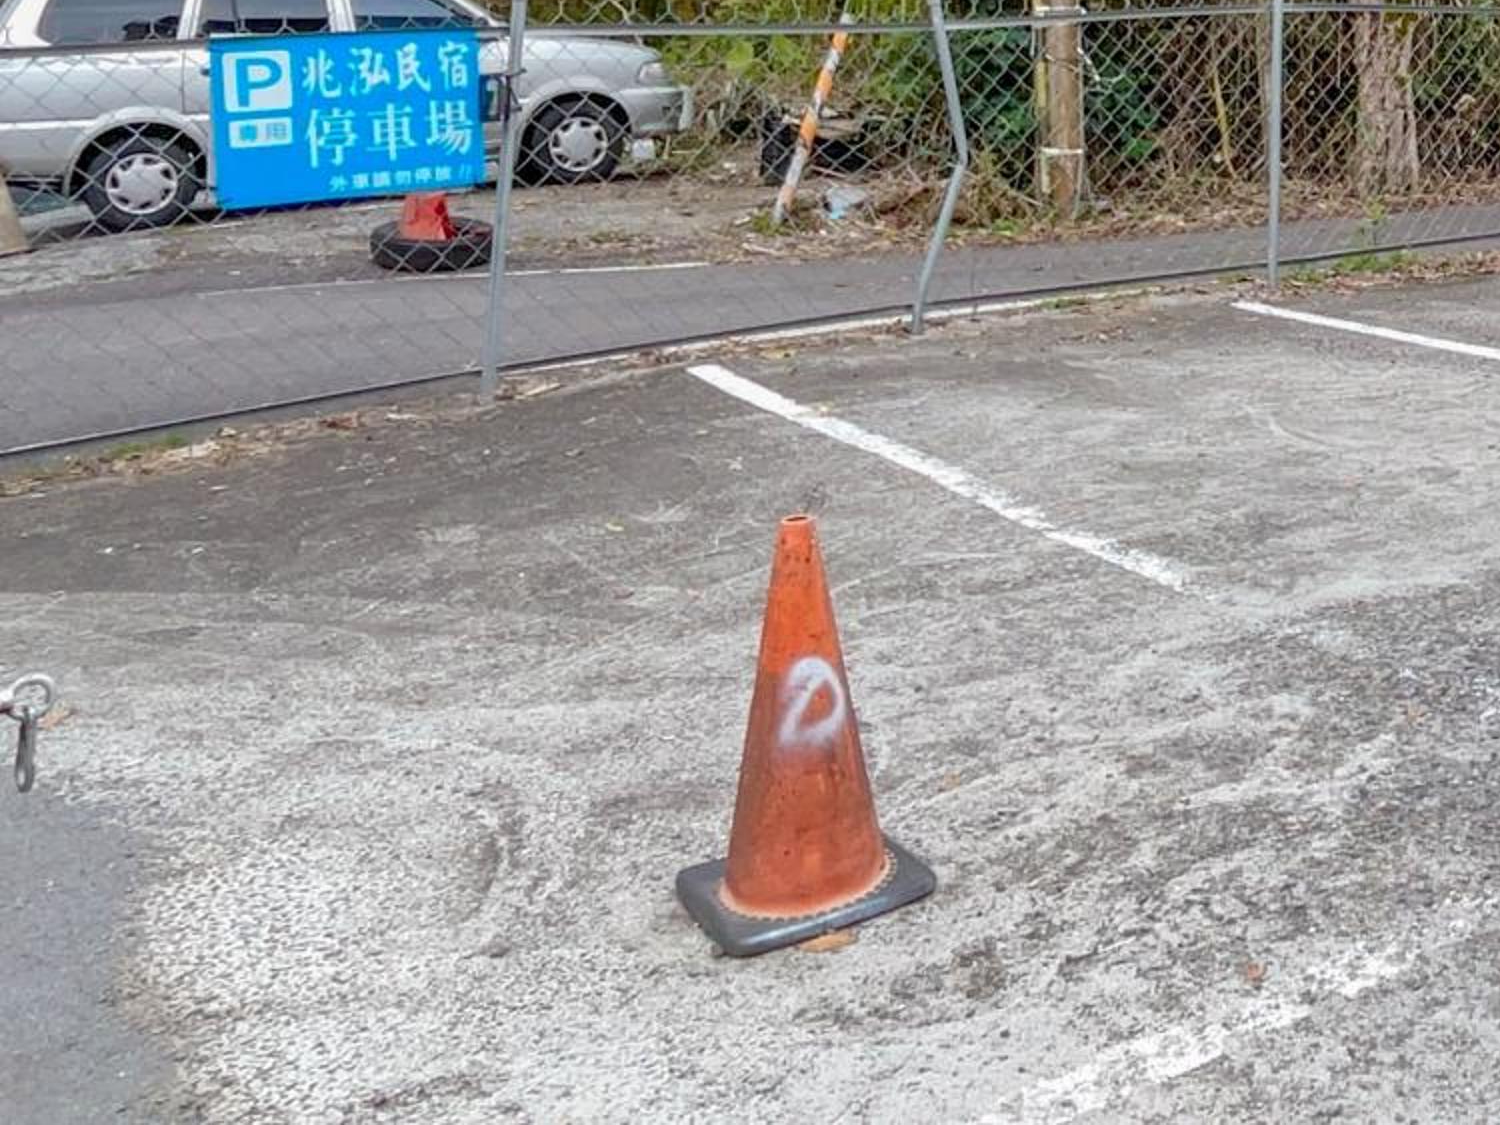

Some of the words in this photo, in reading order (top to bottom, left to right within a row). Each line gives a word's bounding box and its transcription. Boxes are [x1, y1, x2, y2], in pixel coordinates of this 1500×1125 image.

[235, 58, 282, 107] P
[305, 99, 474, 169] 停車場
